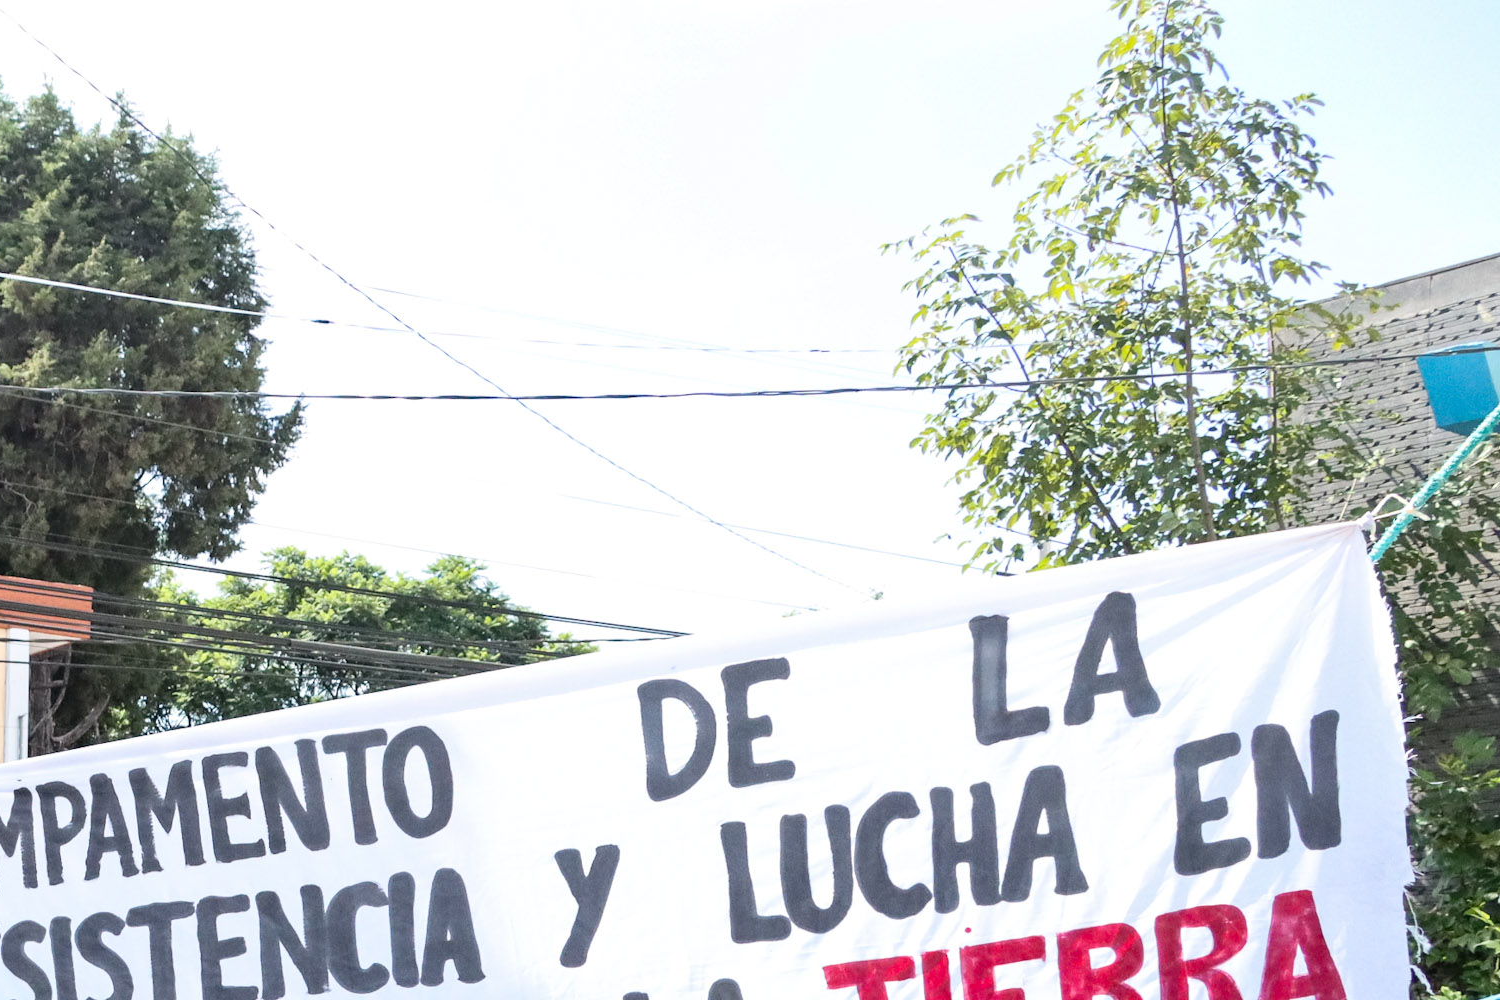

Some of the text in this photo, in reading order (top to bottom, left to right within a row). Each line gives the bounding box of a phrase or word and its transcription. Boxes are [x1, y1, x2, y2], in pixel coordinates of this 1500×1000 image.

[638, 656, 796, 802] DE
[969, 591, 1160, 746] LA
[720, 765, 1089, 944] LUCHA
[1174, 710, 1342, 876] EN
